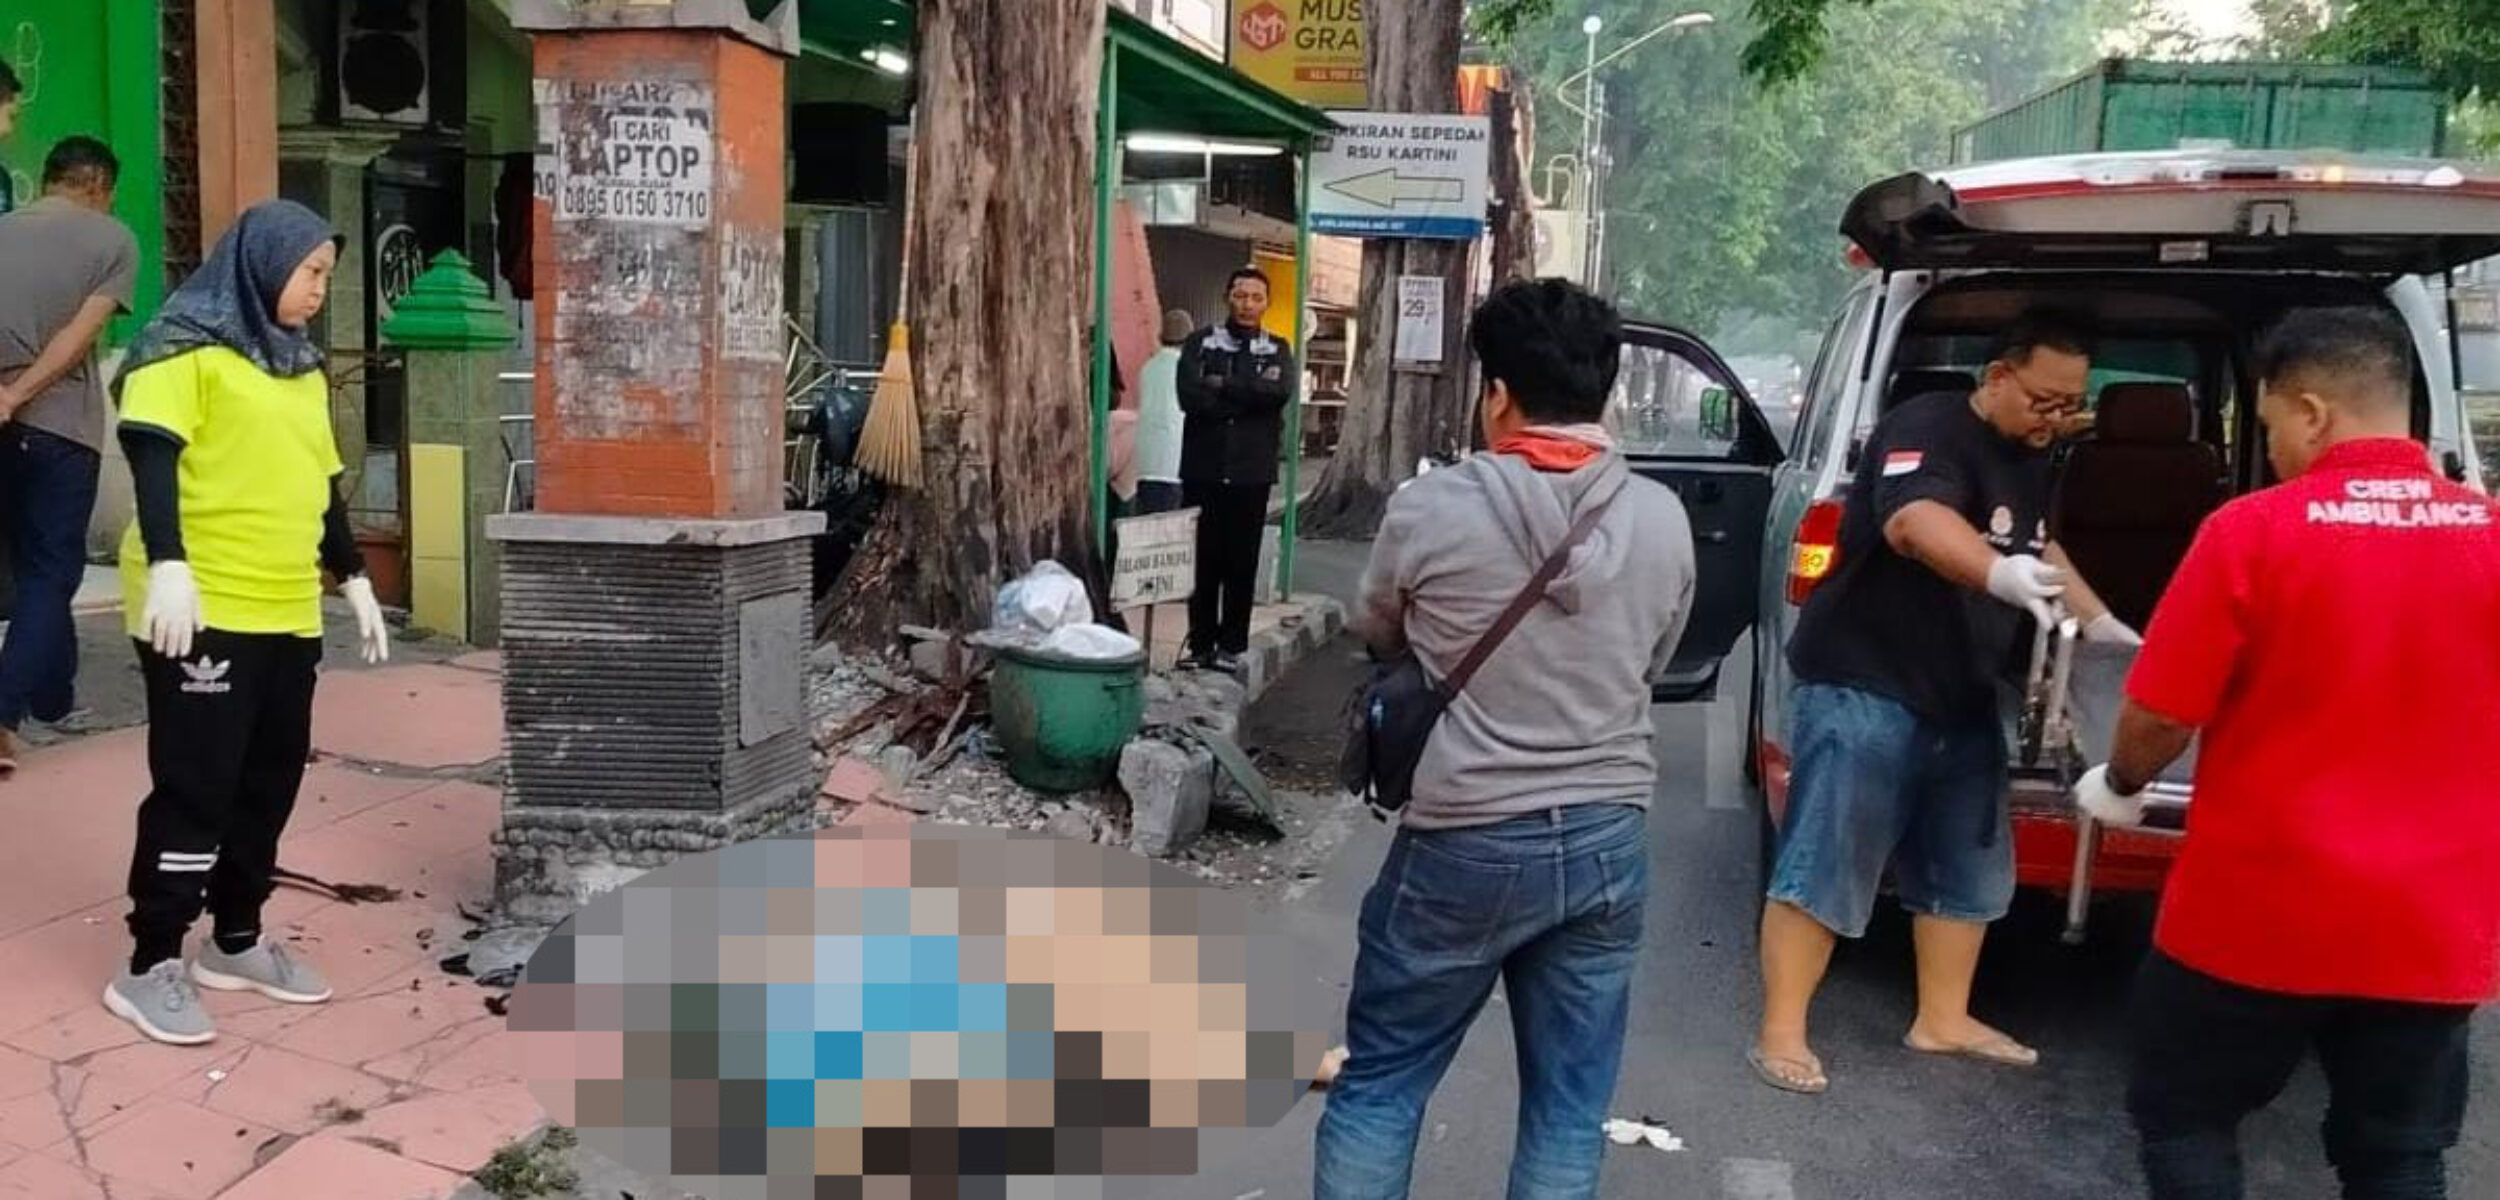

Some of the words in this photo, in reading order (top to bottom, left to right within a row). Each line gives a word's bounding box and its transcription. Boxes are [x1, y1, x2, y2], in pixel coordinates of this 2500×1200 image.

[1294, 26, 1360, 50] GRA
[625, 121, 671, 141] CARI
[591, 144, 700, 179] APTOP
[1347, 144, 1382, 159] RSU
[1388, 146, 1457, 162] KARTINI
[564, 186, 608, 215] 0895
[614, 189, 658, 217] 0150
[663, 190, 708, 219] 3710
[2344, 478, 2432, 499] CREW
[2306, 500, 2493, 528] AMBULANCE
